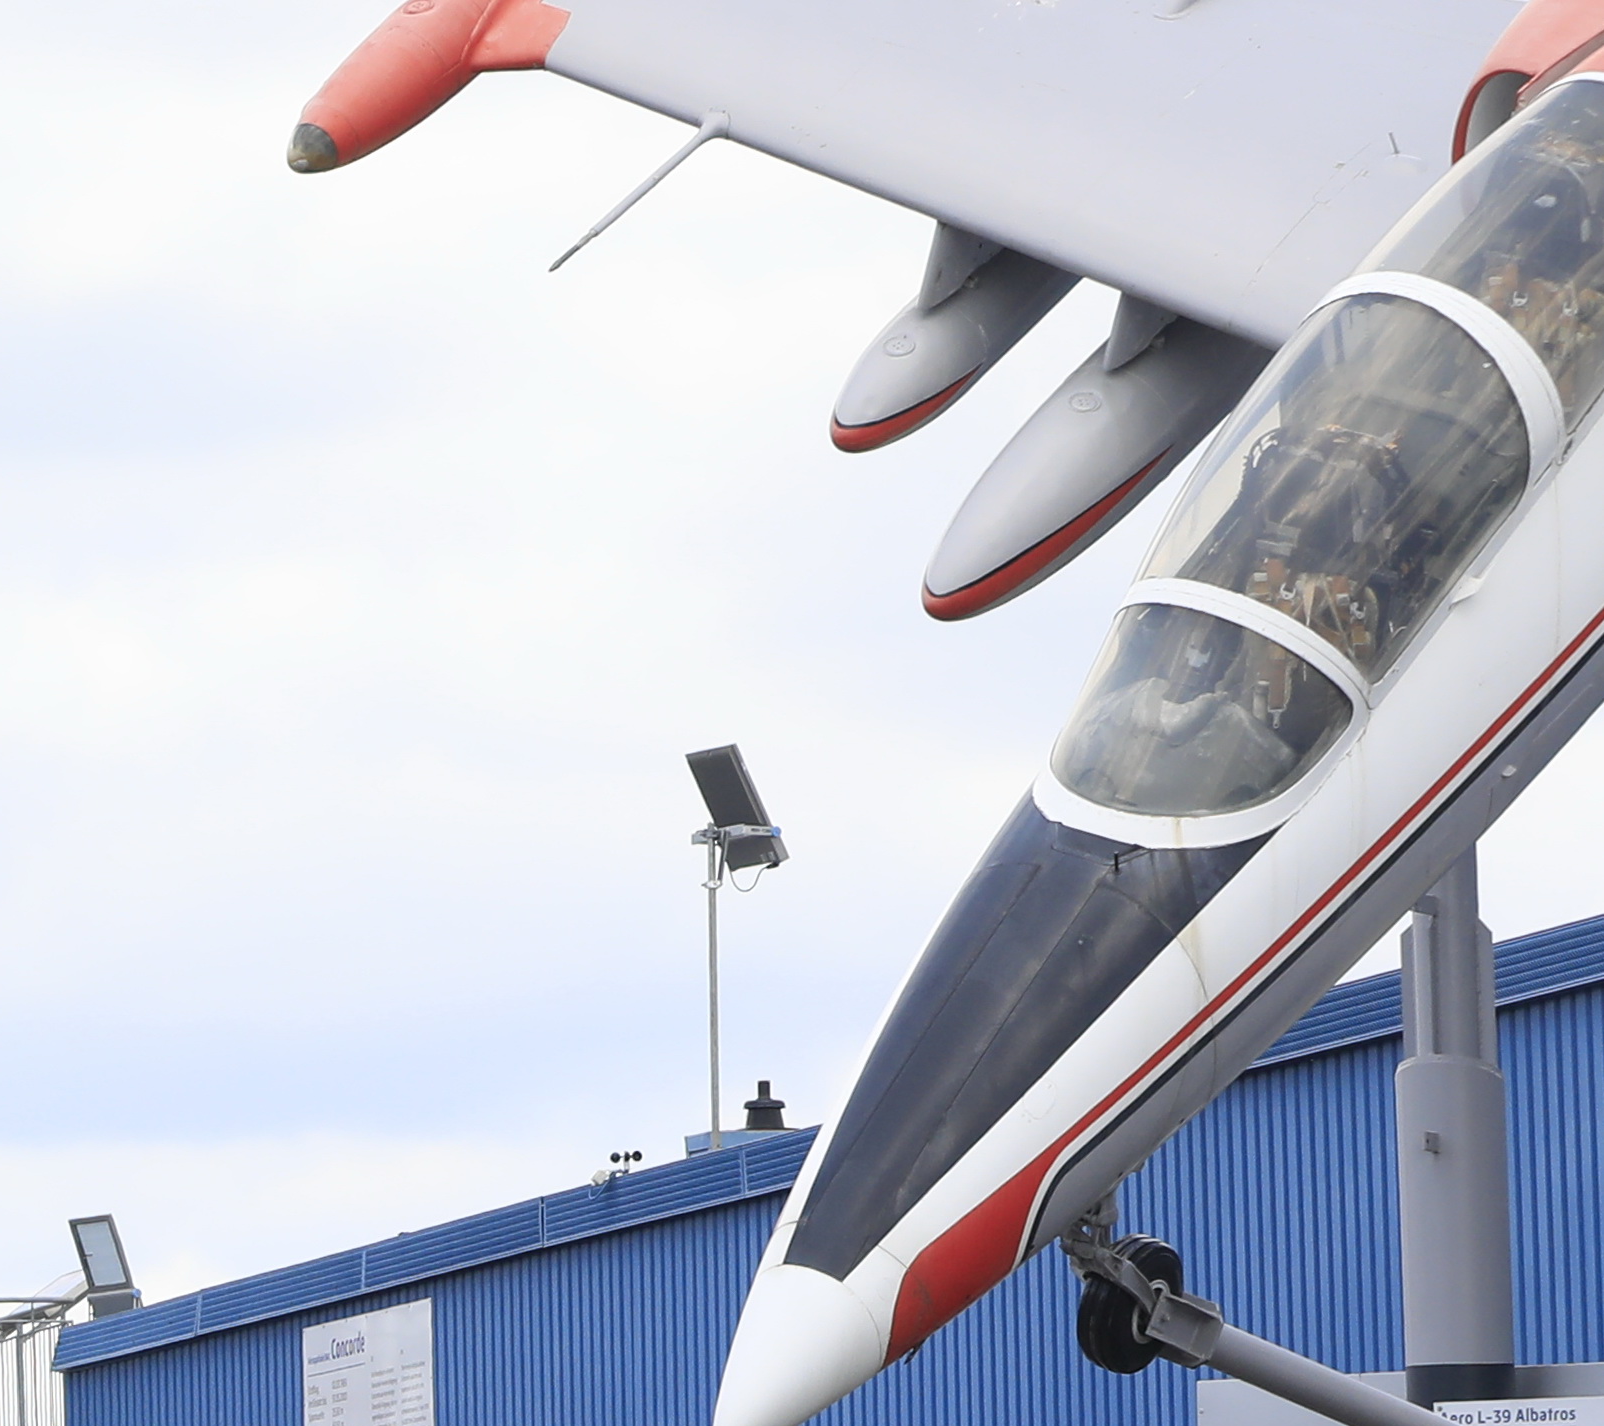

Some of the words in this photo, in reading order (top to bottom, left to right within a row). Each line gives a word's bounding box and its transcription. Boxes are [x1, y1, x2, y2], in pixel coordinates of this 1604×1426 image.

[330, 1330, 366, 1361] Concorde
[1477, 1409, 1511, 1425] L-39
[1514, 1407, 1577, 1424] Albatros
